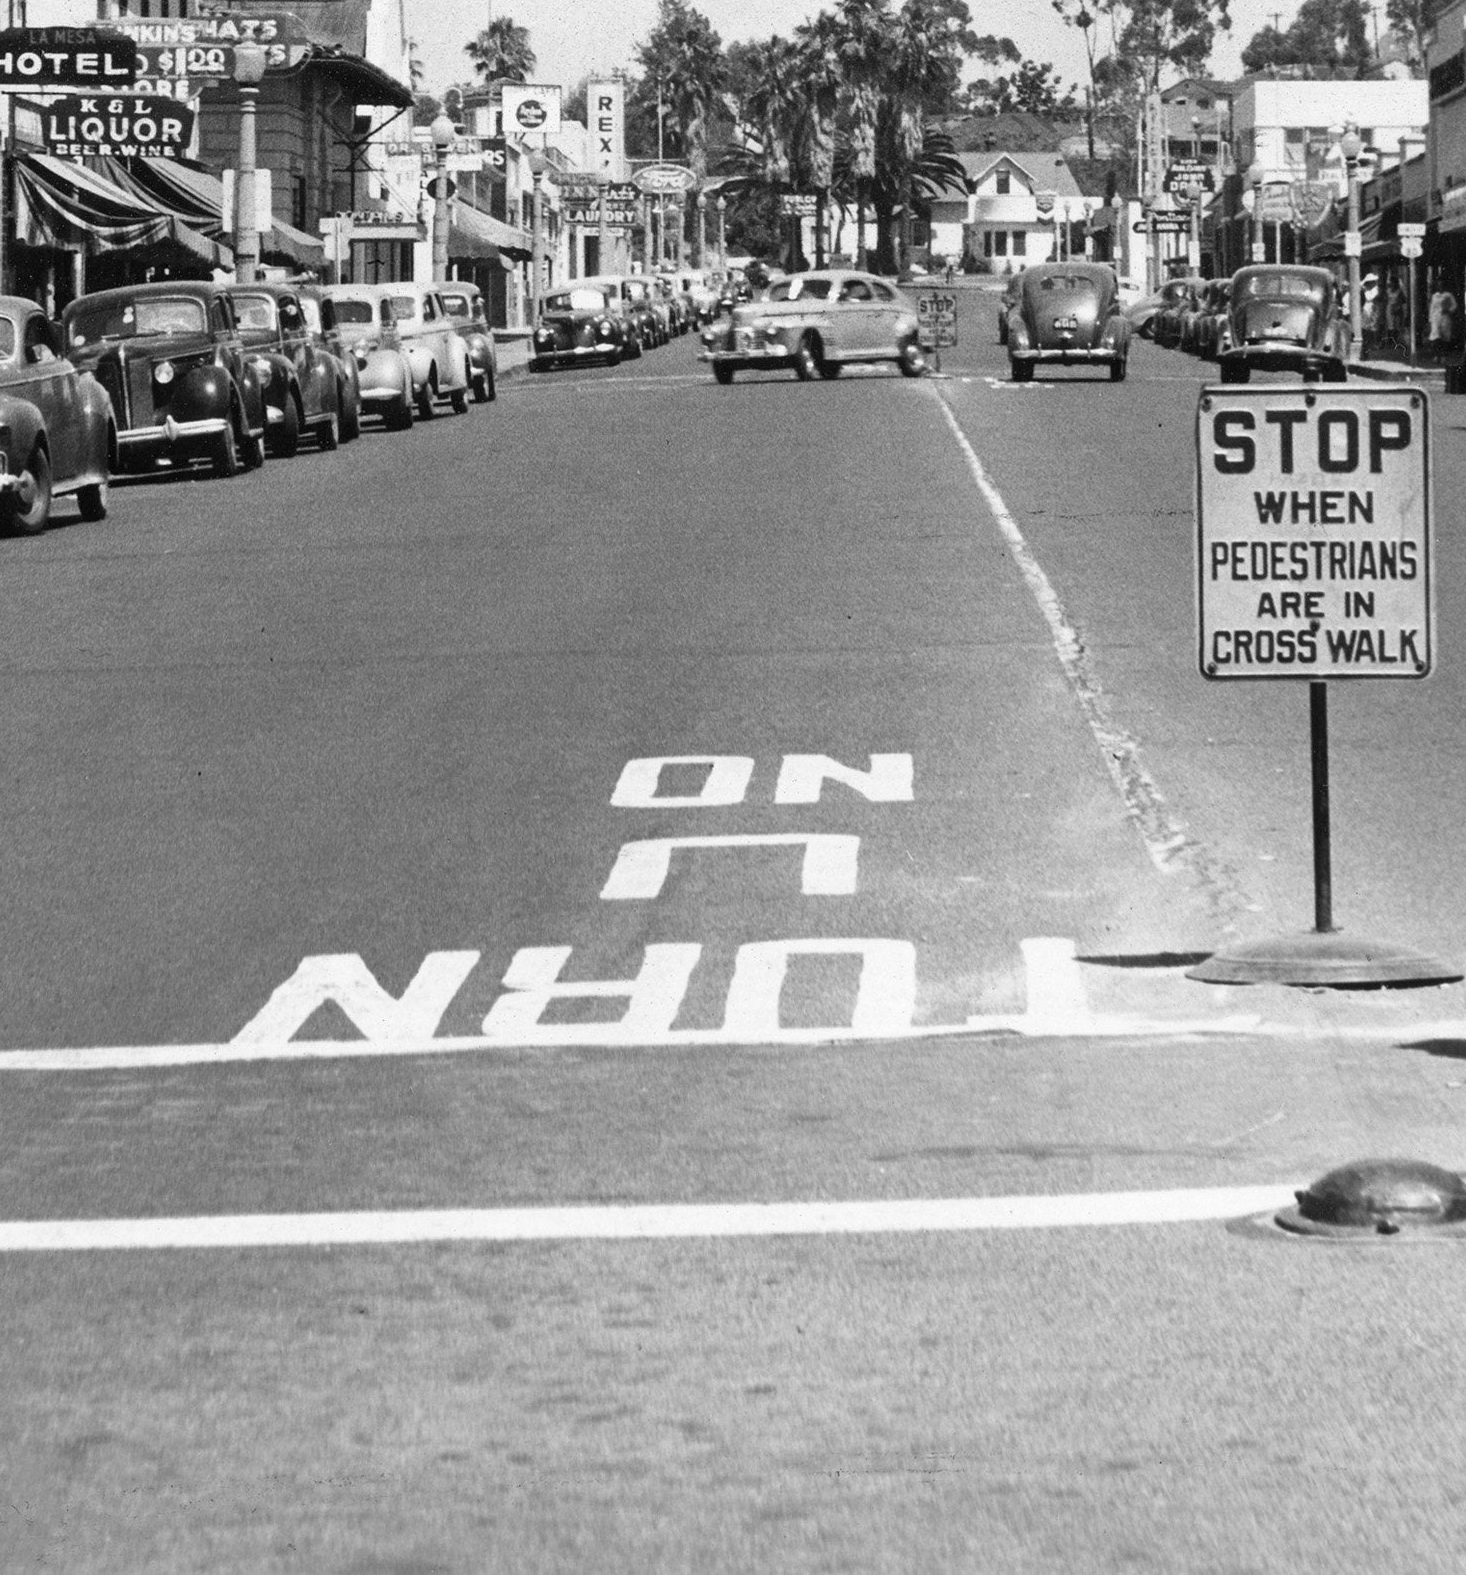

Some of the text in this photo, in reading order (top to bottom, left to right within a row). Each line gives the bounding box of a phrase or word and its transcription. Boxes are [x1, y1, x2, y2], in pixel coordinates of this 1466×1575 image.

[30, 31, 96, 43] LA MESA
[80, 100, 151, 113] K & L
[50, 116, 182, 142] LIQUOR
[920, 299, 953, 312] STOP
[1213, 409, 1411, 474] STOP
[1254, 491, 1373, 524] WHEN
[1211, 541, 1417, 581] PEDESTRIANS
[1257, 591, 1374, 618] ARE IN
[1213, 629, 1420, 664] CROSS WALK
[229, 937, 1260, 1043] TURN
